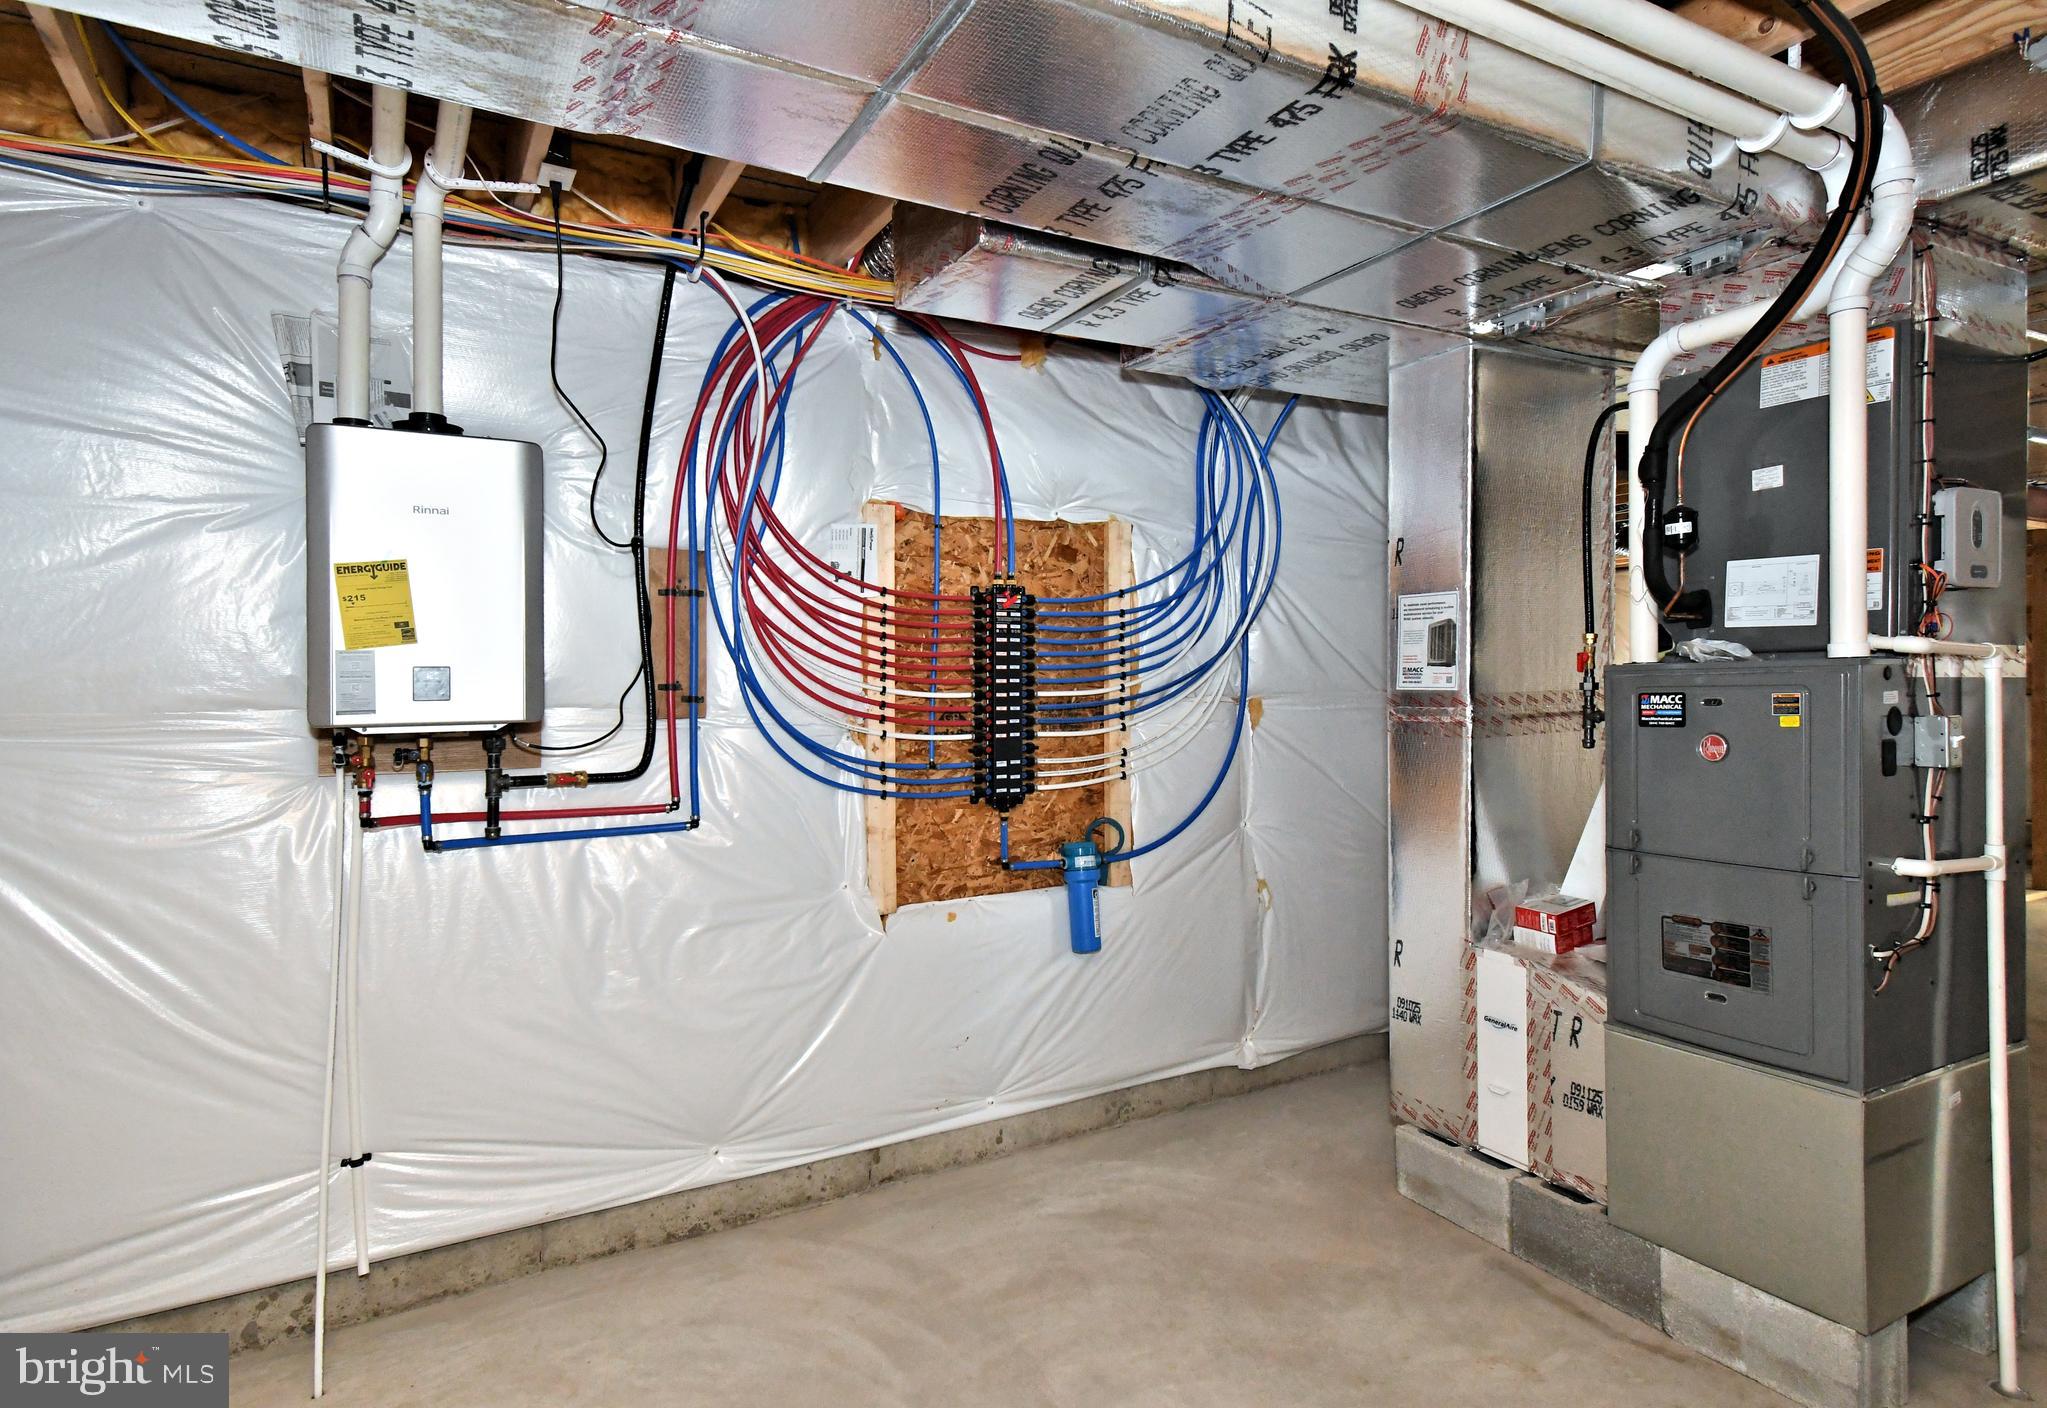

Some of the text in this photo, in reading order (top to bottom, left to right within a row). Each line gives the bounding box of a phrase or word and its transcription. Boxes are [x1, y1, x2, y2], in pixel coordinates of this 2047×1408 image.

[1120, 77, 1222, 145] CORNING
[1206, 130, 1277, 163] TYPE
[1265, 100, 1325, 129] 475
[979, 162, 1058, 214] CORNING
[1054, 198, 1112, 227] TYPE
[1097, 174, 1146, 198] 475
[1593, 187, 1701, 238] CORNING
[1640, 220, 1713, 247] TYPE
[1018, 296, 1068, 321] OWENS
[1053, 257, 1121, 300] CORNING
[1118, 287, 1162, 307] TYPE
[1396, 284, 1457, 310] OWENS
[1503, 274, 1562, 297] TYPE
[412, 504, 450, 516] Rinnai
[1394, 537, 1405, 567] R
[336, 562, 407, 580] ENERGYGUIDE
[342, 594, 366, 602] $215
[1650, 694, 1683, 704] MACC
[1393, 939, 1404, 968] R
[1483, 1015, 1518, 1032] GeneralAire
[1569, 1015, 1582, 1048] R
